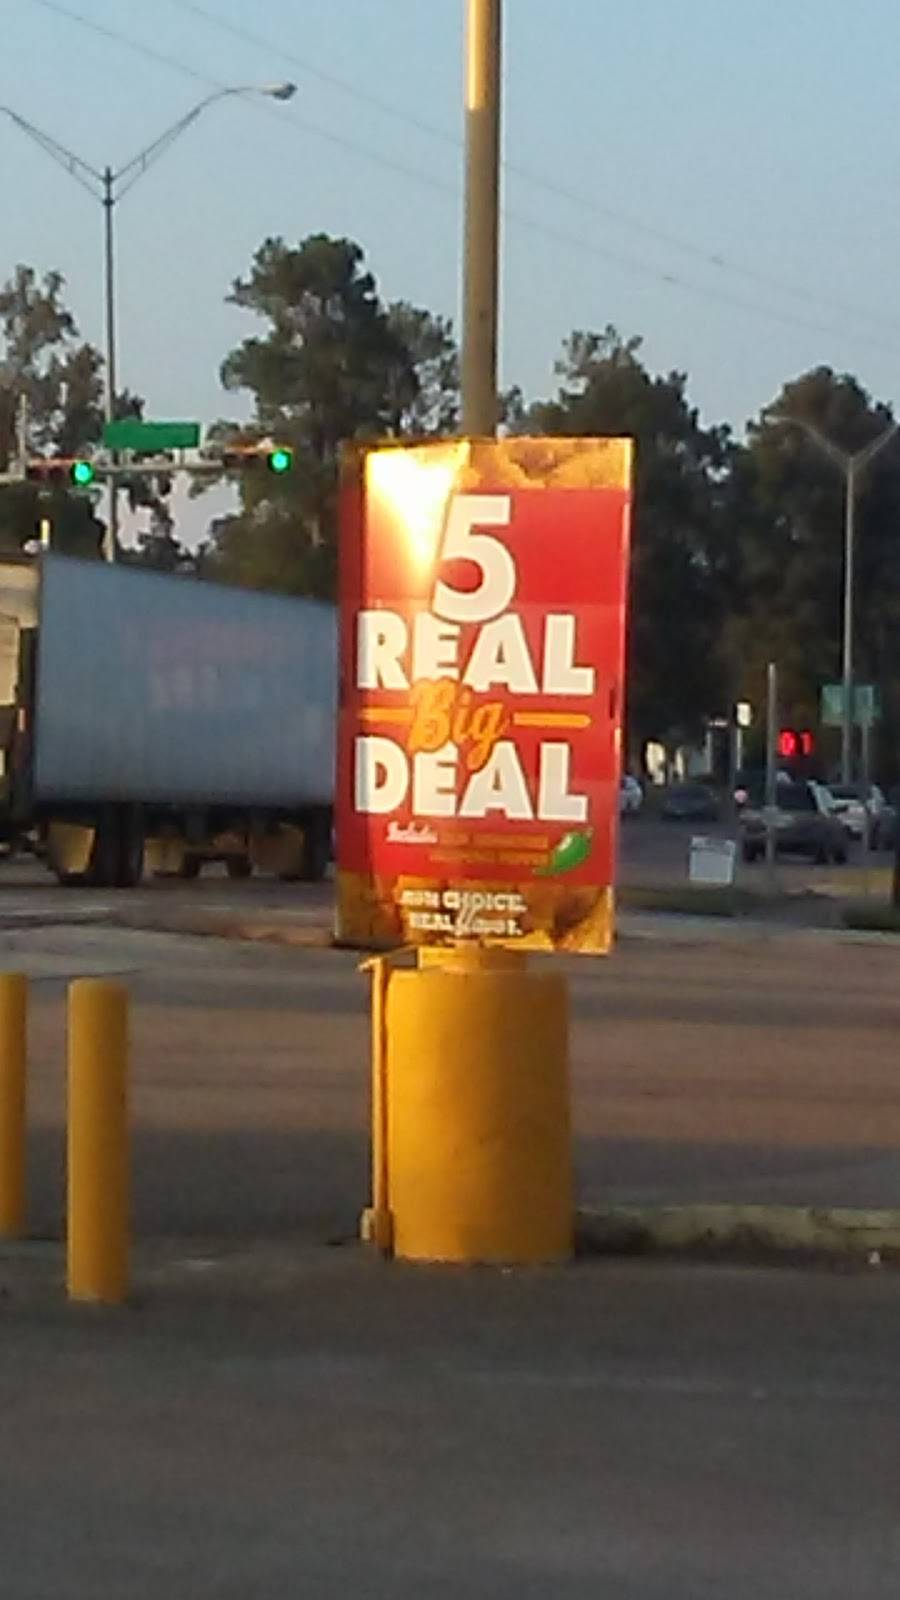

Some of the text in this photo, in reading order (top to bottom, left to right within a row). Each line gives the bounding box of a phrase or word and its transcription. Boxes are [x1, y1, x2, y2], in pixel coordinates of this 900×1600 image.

[432, 494, 516, 623] 5
[356, 609, 596, 695] REAL
[407, 677, 510, 770] Big
[354, 736, 589, 823] DEAL
